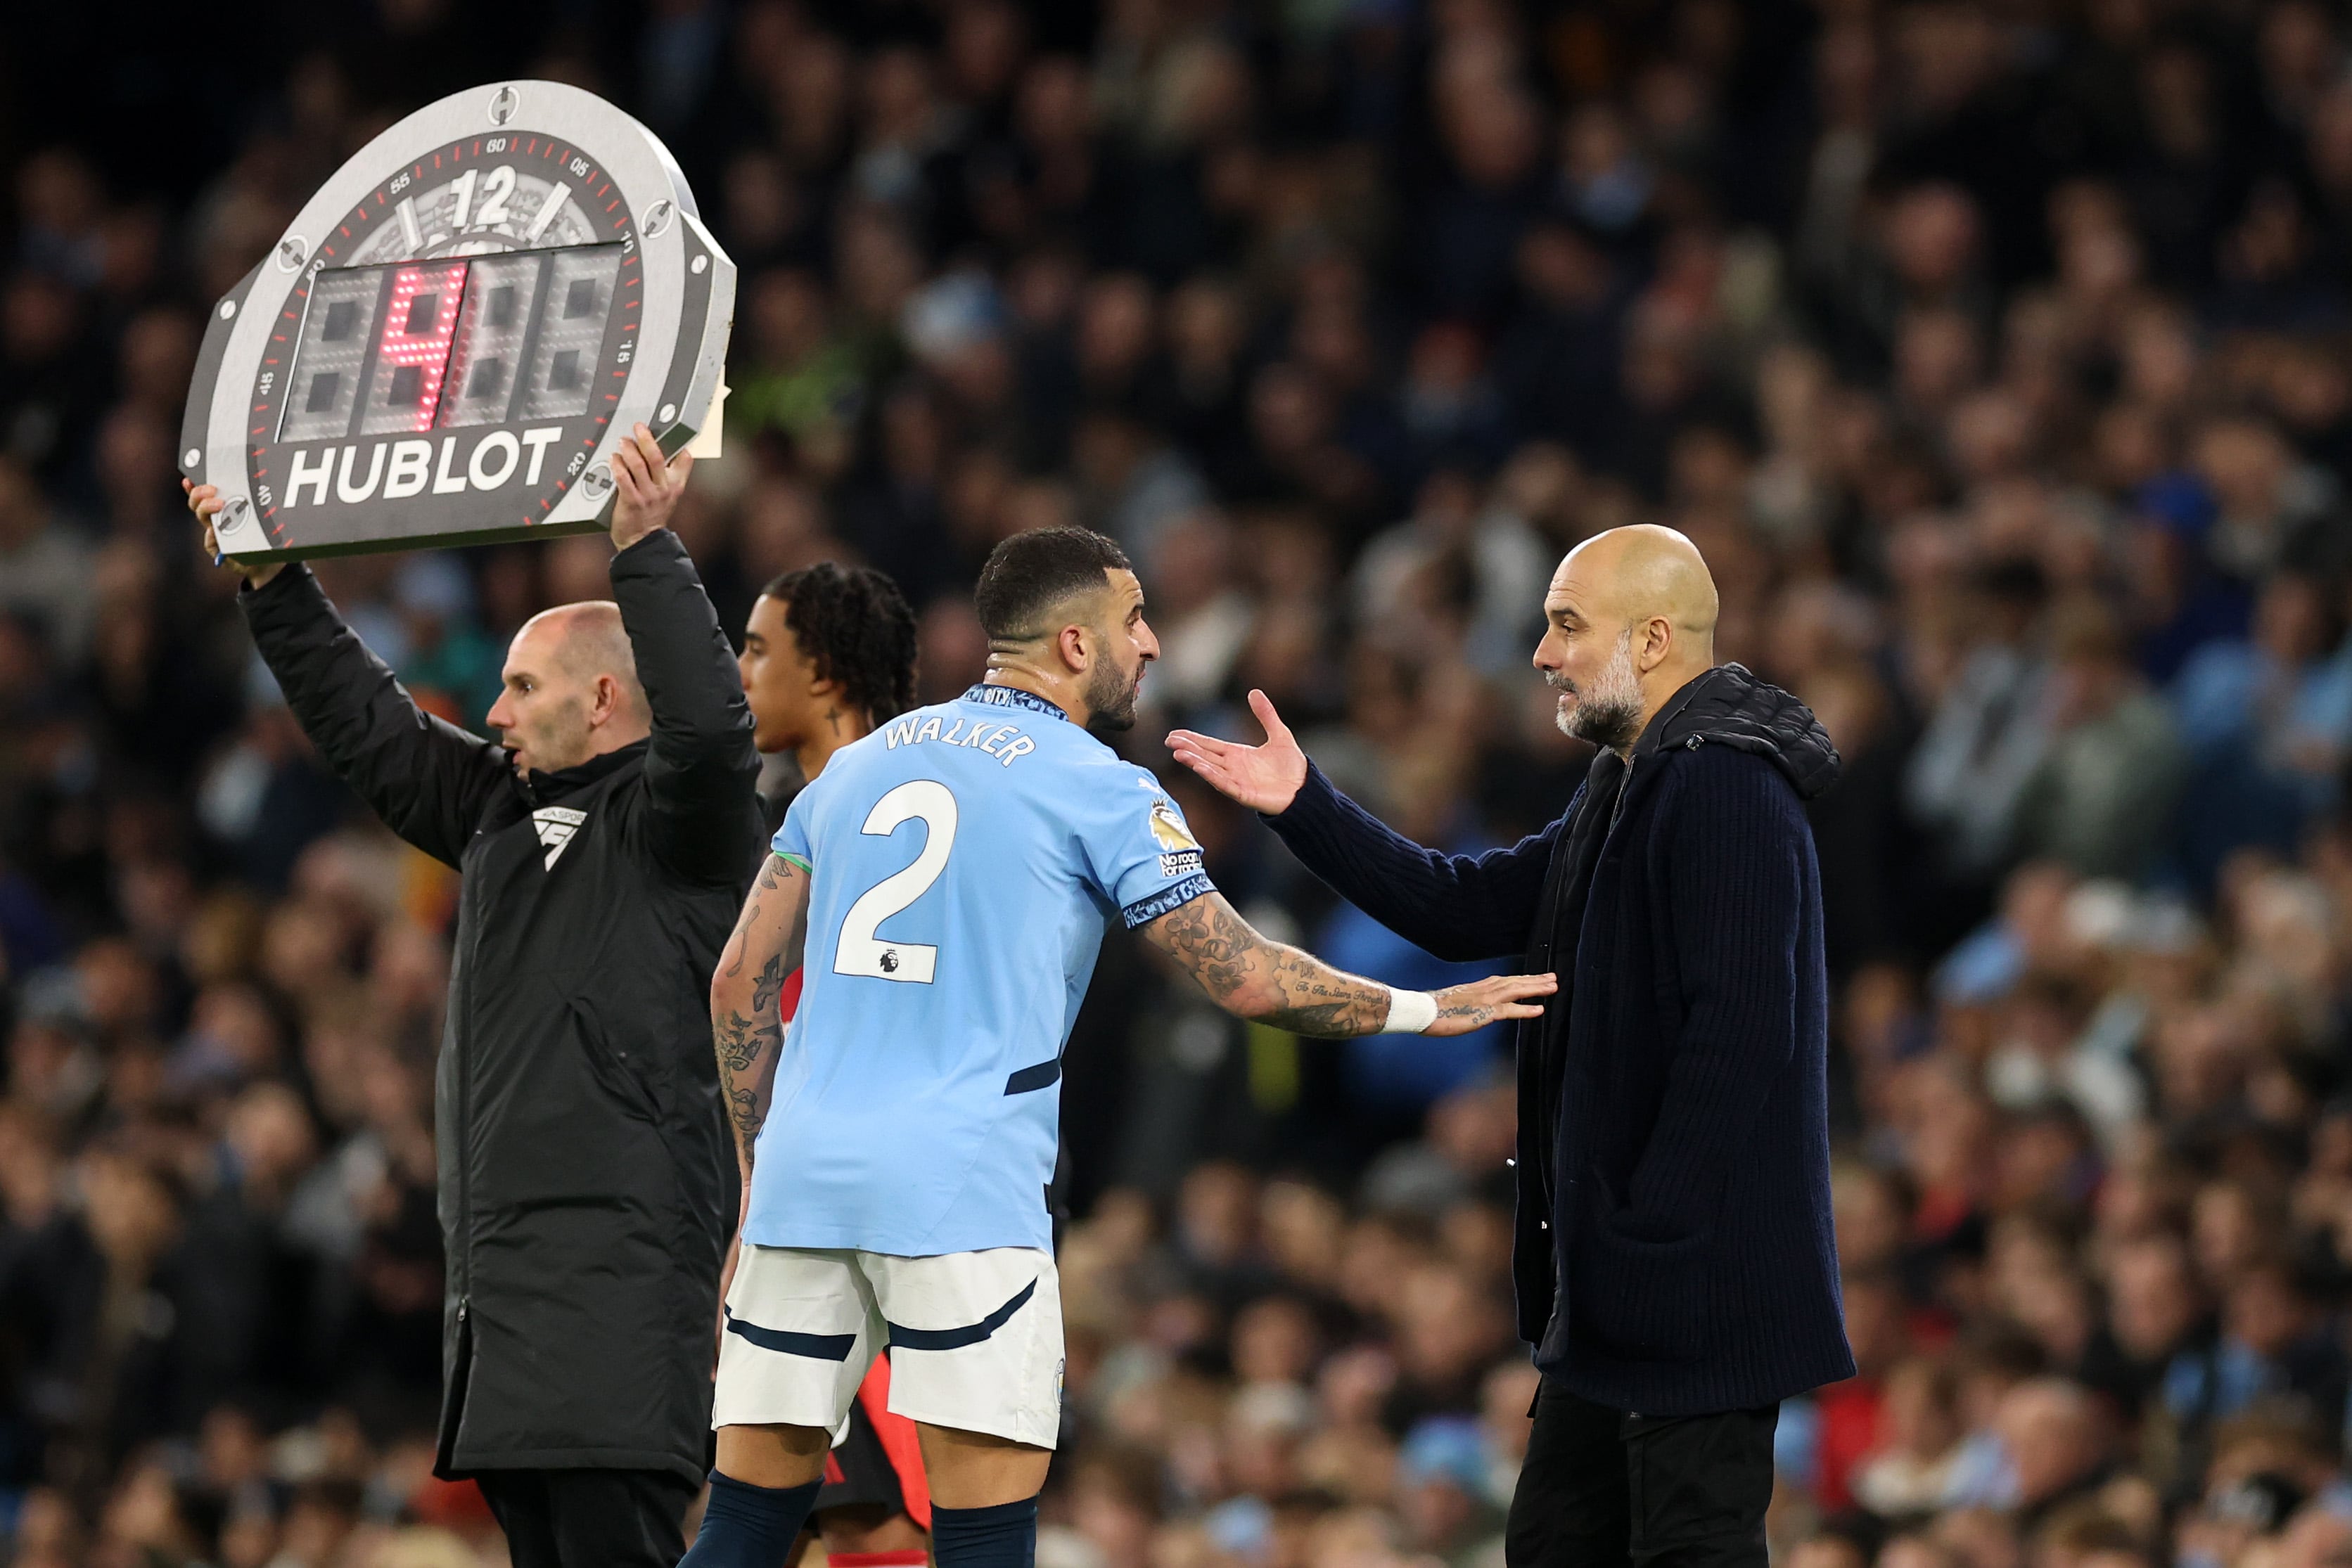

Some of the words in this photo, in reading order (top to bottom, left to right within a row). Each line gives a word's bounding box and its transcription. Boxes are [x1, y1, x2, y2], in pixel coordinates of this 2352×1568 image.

[486, 138, 506, 153] 60
[570, 157, 589, 176] 05
[390, 173, 410, 194] 55
[450, 165, 516, 228] 12
[382, 264, 466, 432] 4
[617, 340, 632, 364] 15
[260, 372, 274, 395] 45
[283, 426, 563, 508] HUBLOT
[567, 451, 586, 476] 20
[257, 484, 273, 506] 40
[885, 716, 1035, 768] WALKER
[558, 811, 584, 822] SPOR
[1158, 854, 1177, 866] No
[833, 778, 959, 984] 2
